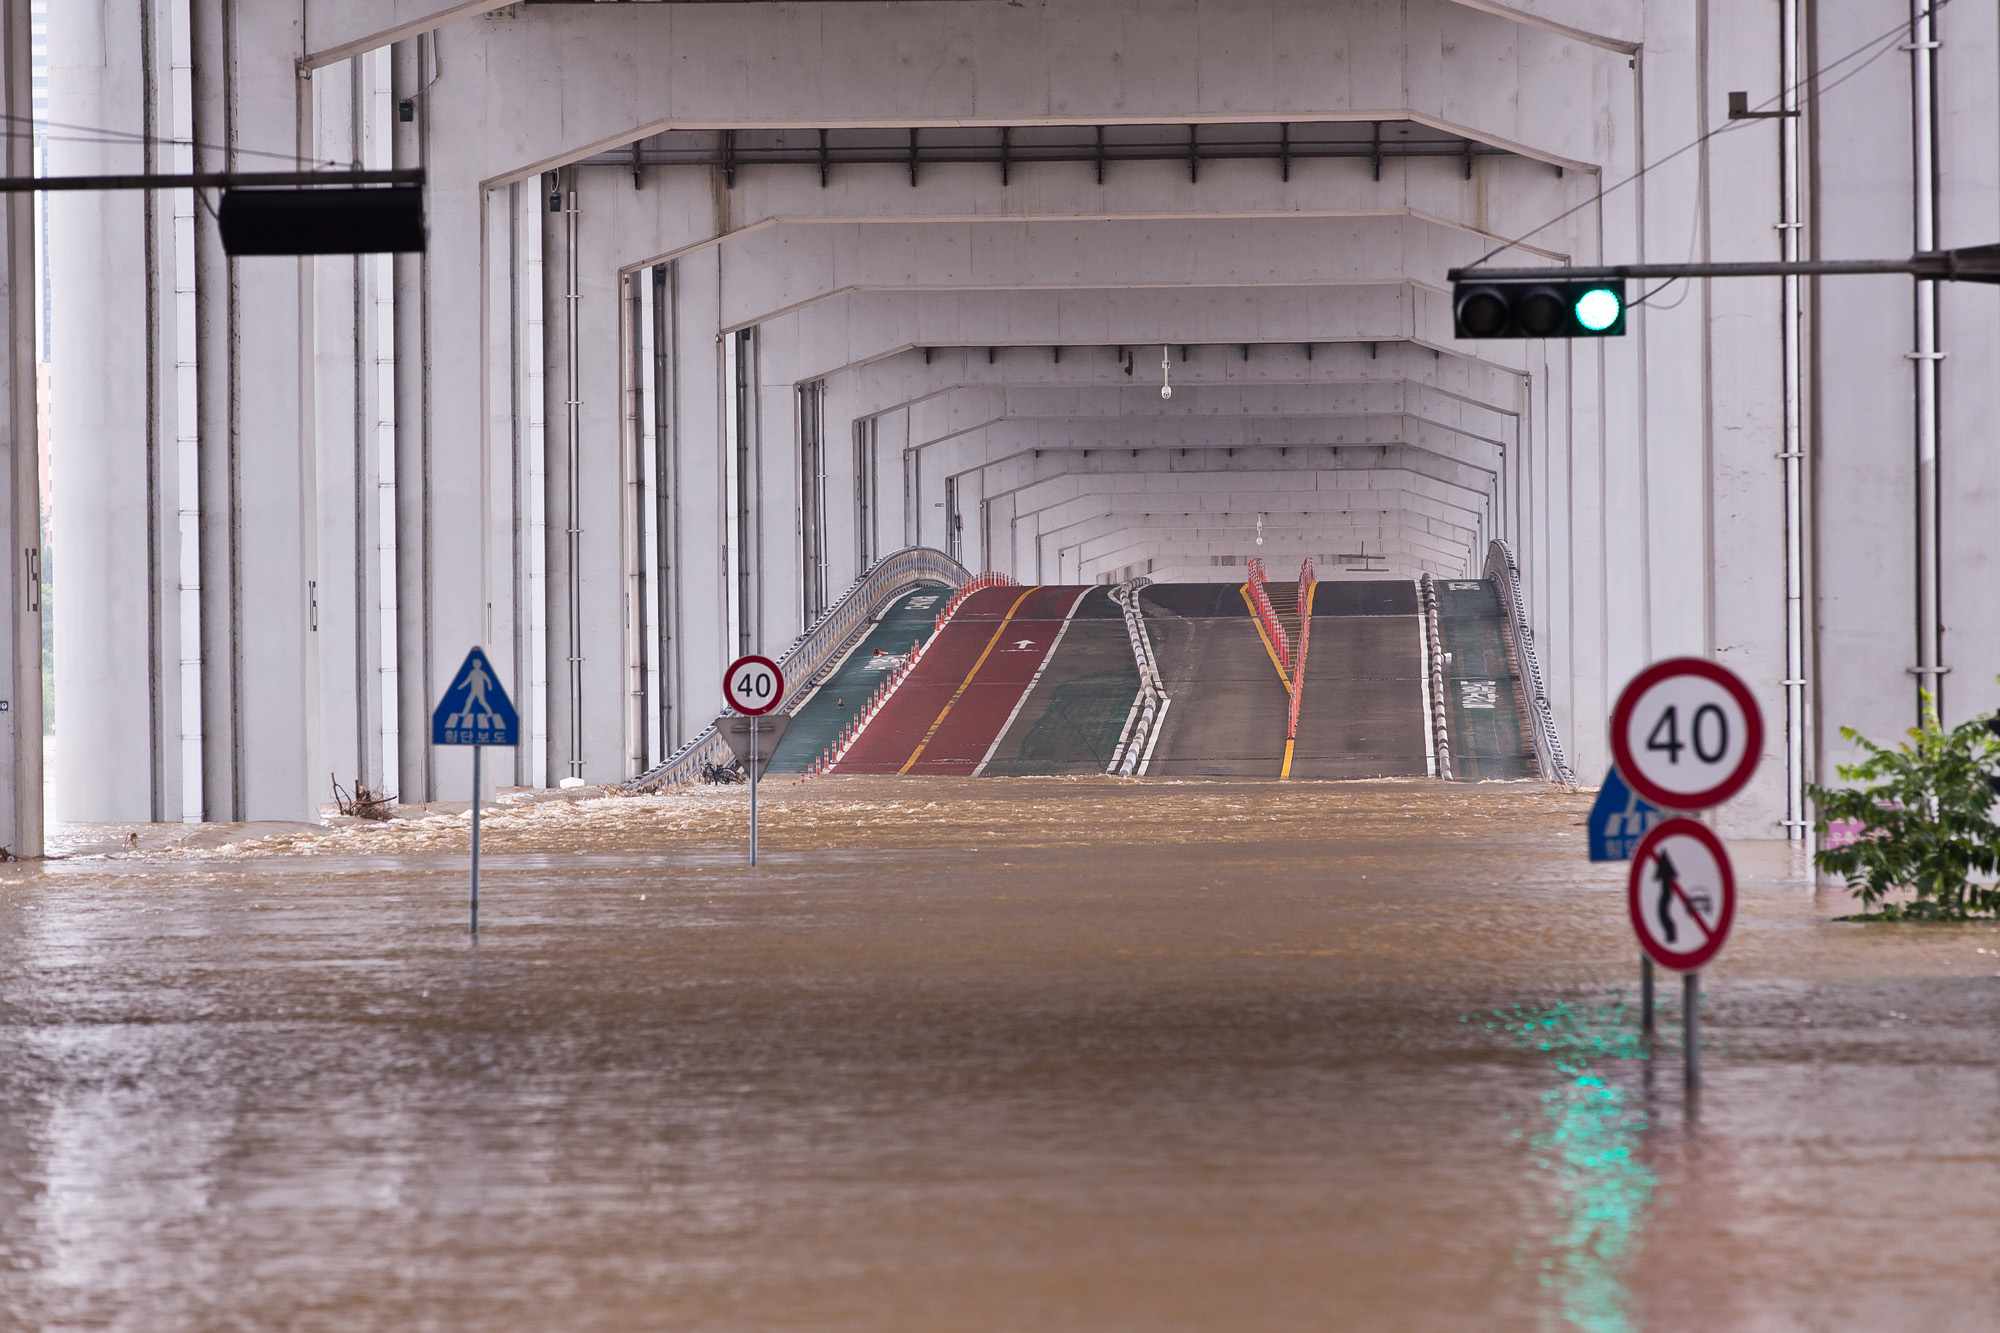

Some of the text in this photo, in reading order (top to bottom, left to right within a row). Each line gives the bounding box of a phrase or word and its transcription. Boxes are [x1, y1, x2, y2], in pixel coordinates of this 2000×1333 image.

[25, 548, 38, 611] 15
[309, 580, 318, 632] 16
[737, 673, 770, 698] 40
[445, 730, 507, 744] 횡단보도
[1645, 703, 1730, 764] 40
